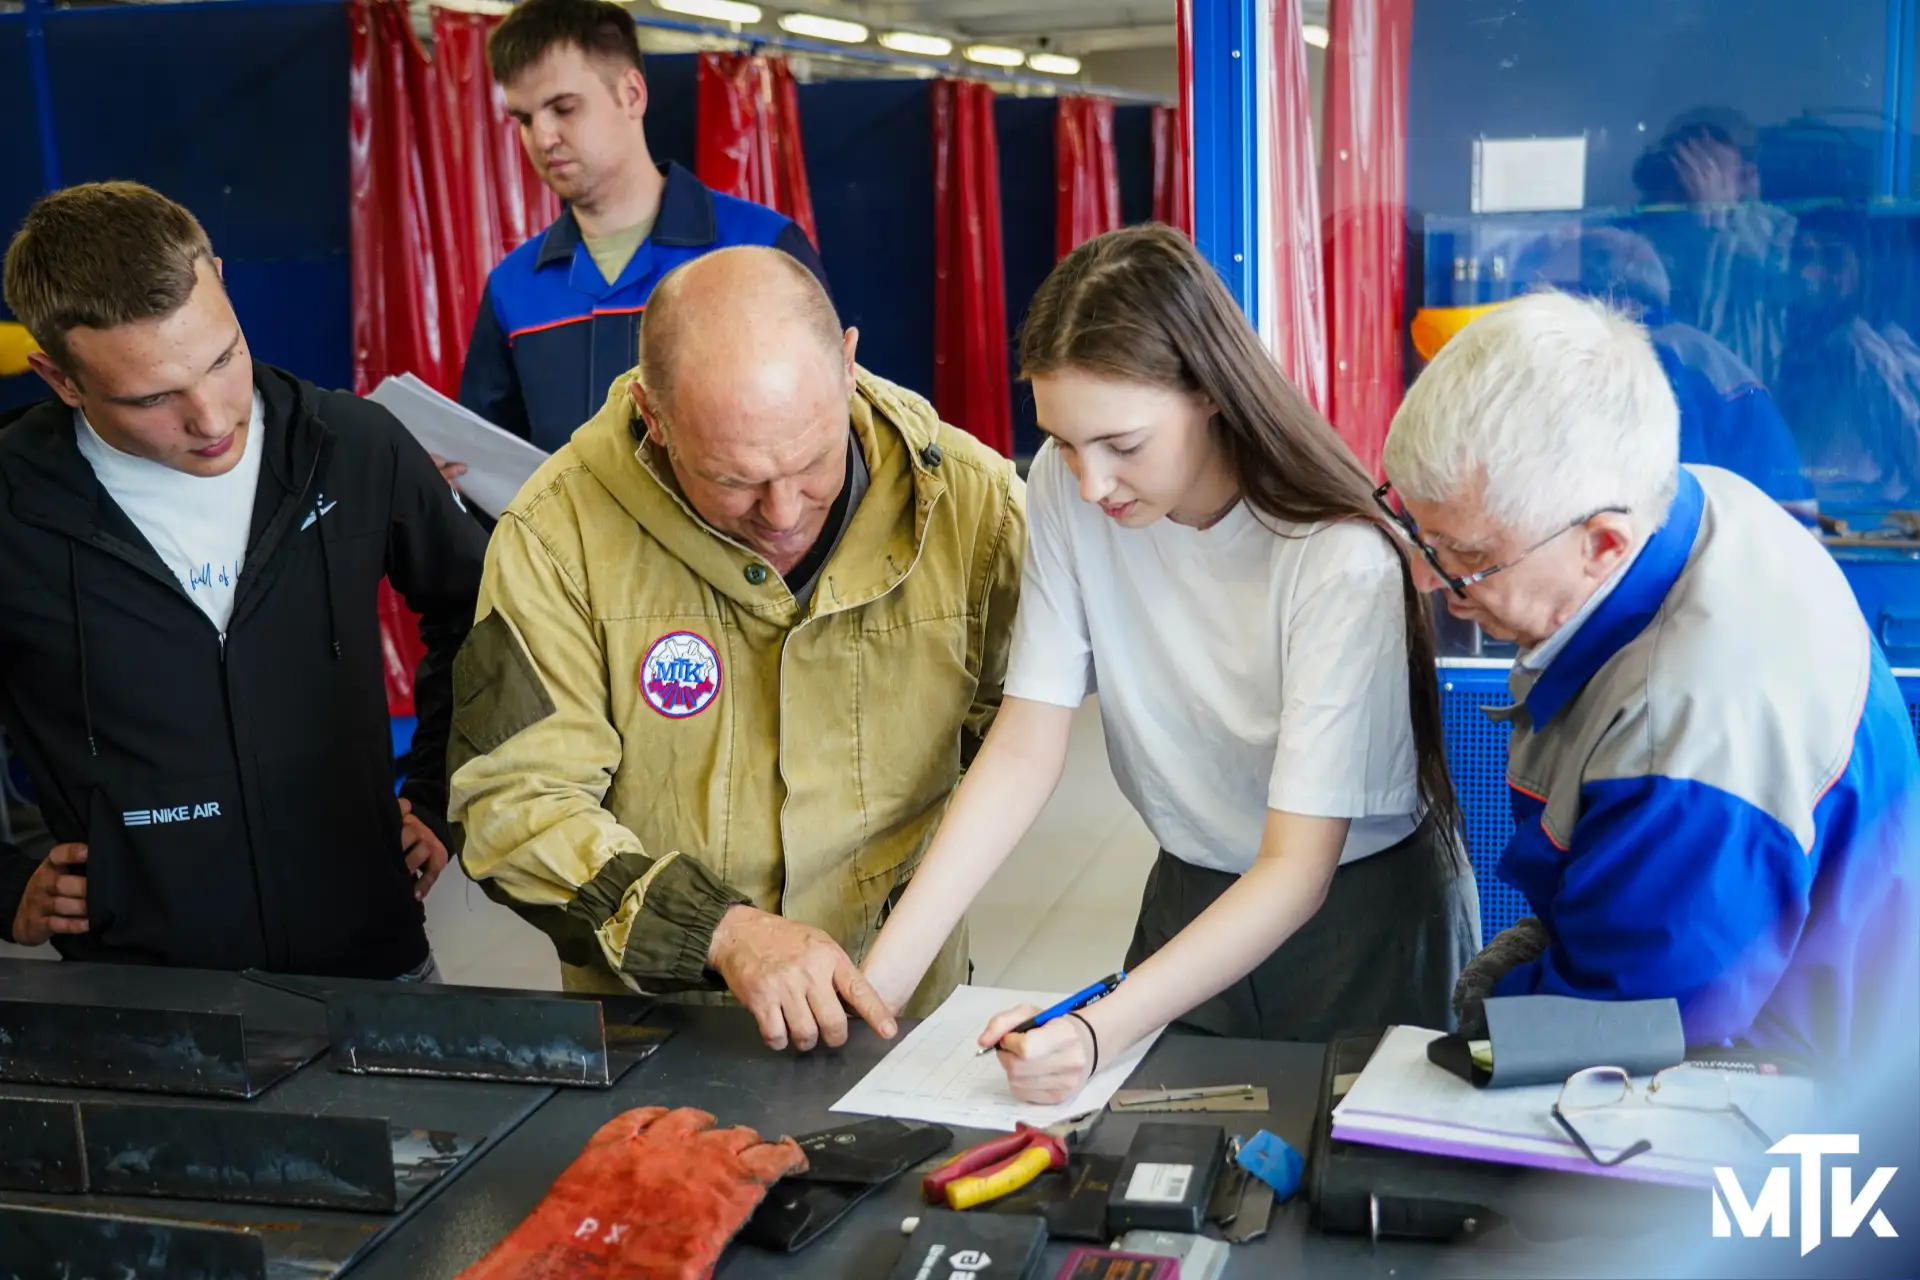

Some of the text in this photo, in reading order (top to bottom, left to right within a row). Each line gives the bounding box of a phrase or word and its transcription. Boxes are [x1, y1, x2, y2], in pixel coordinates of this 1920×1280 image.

[218, 565, 230, 588] of
[151, 801, 222, 824] NIKE AIR
